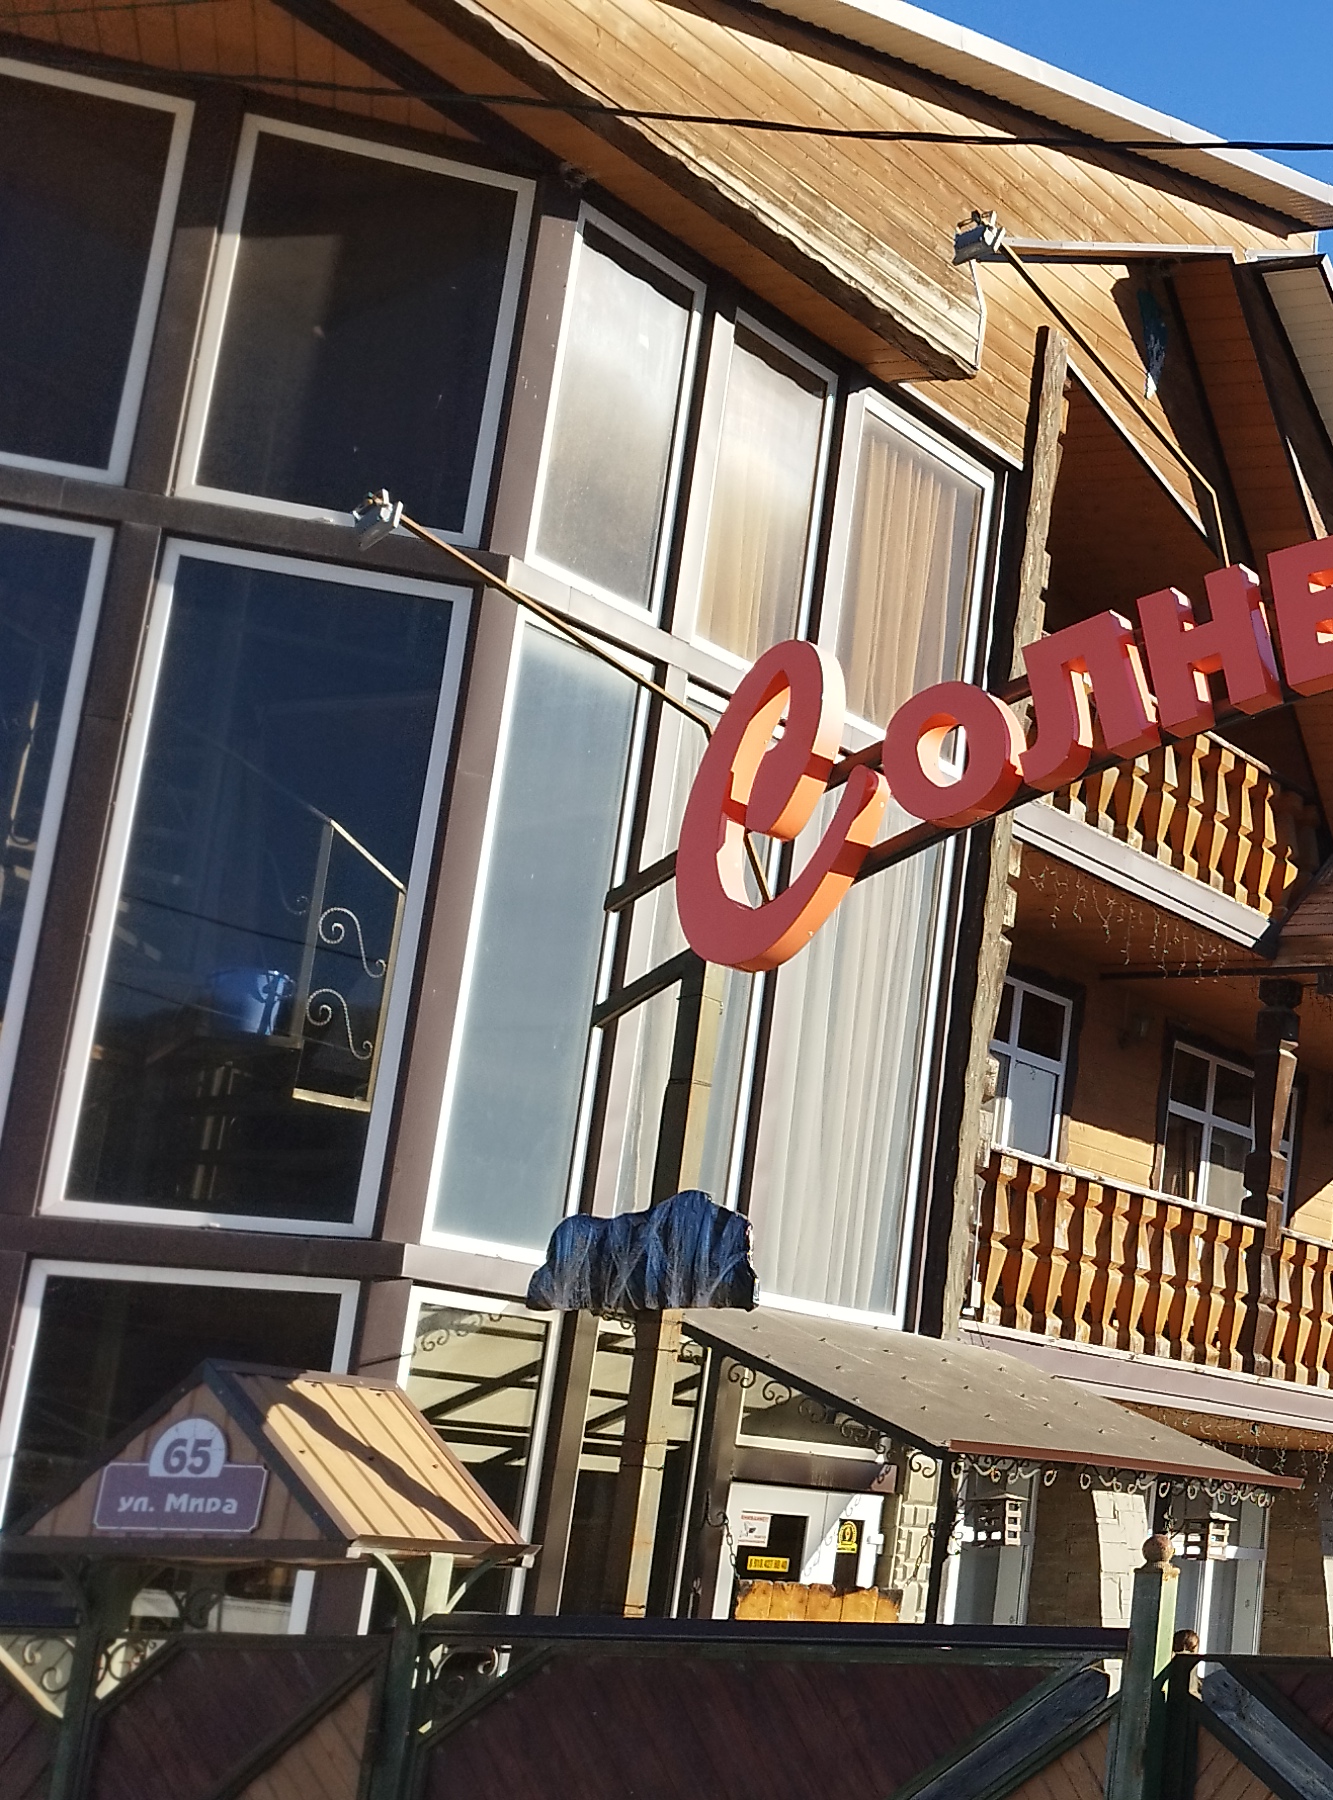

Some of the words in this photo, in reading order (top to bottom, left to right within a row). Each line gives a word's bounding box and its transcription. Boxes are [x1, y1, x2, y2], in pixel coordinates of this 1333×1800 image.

[162, 1438, 213, 1475] 65
[117, 1496, 155, 1512] ул.
[164, 1493, 239, 1514] Мира
